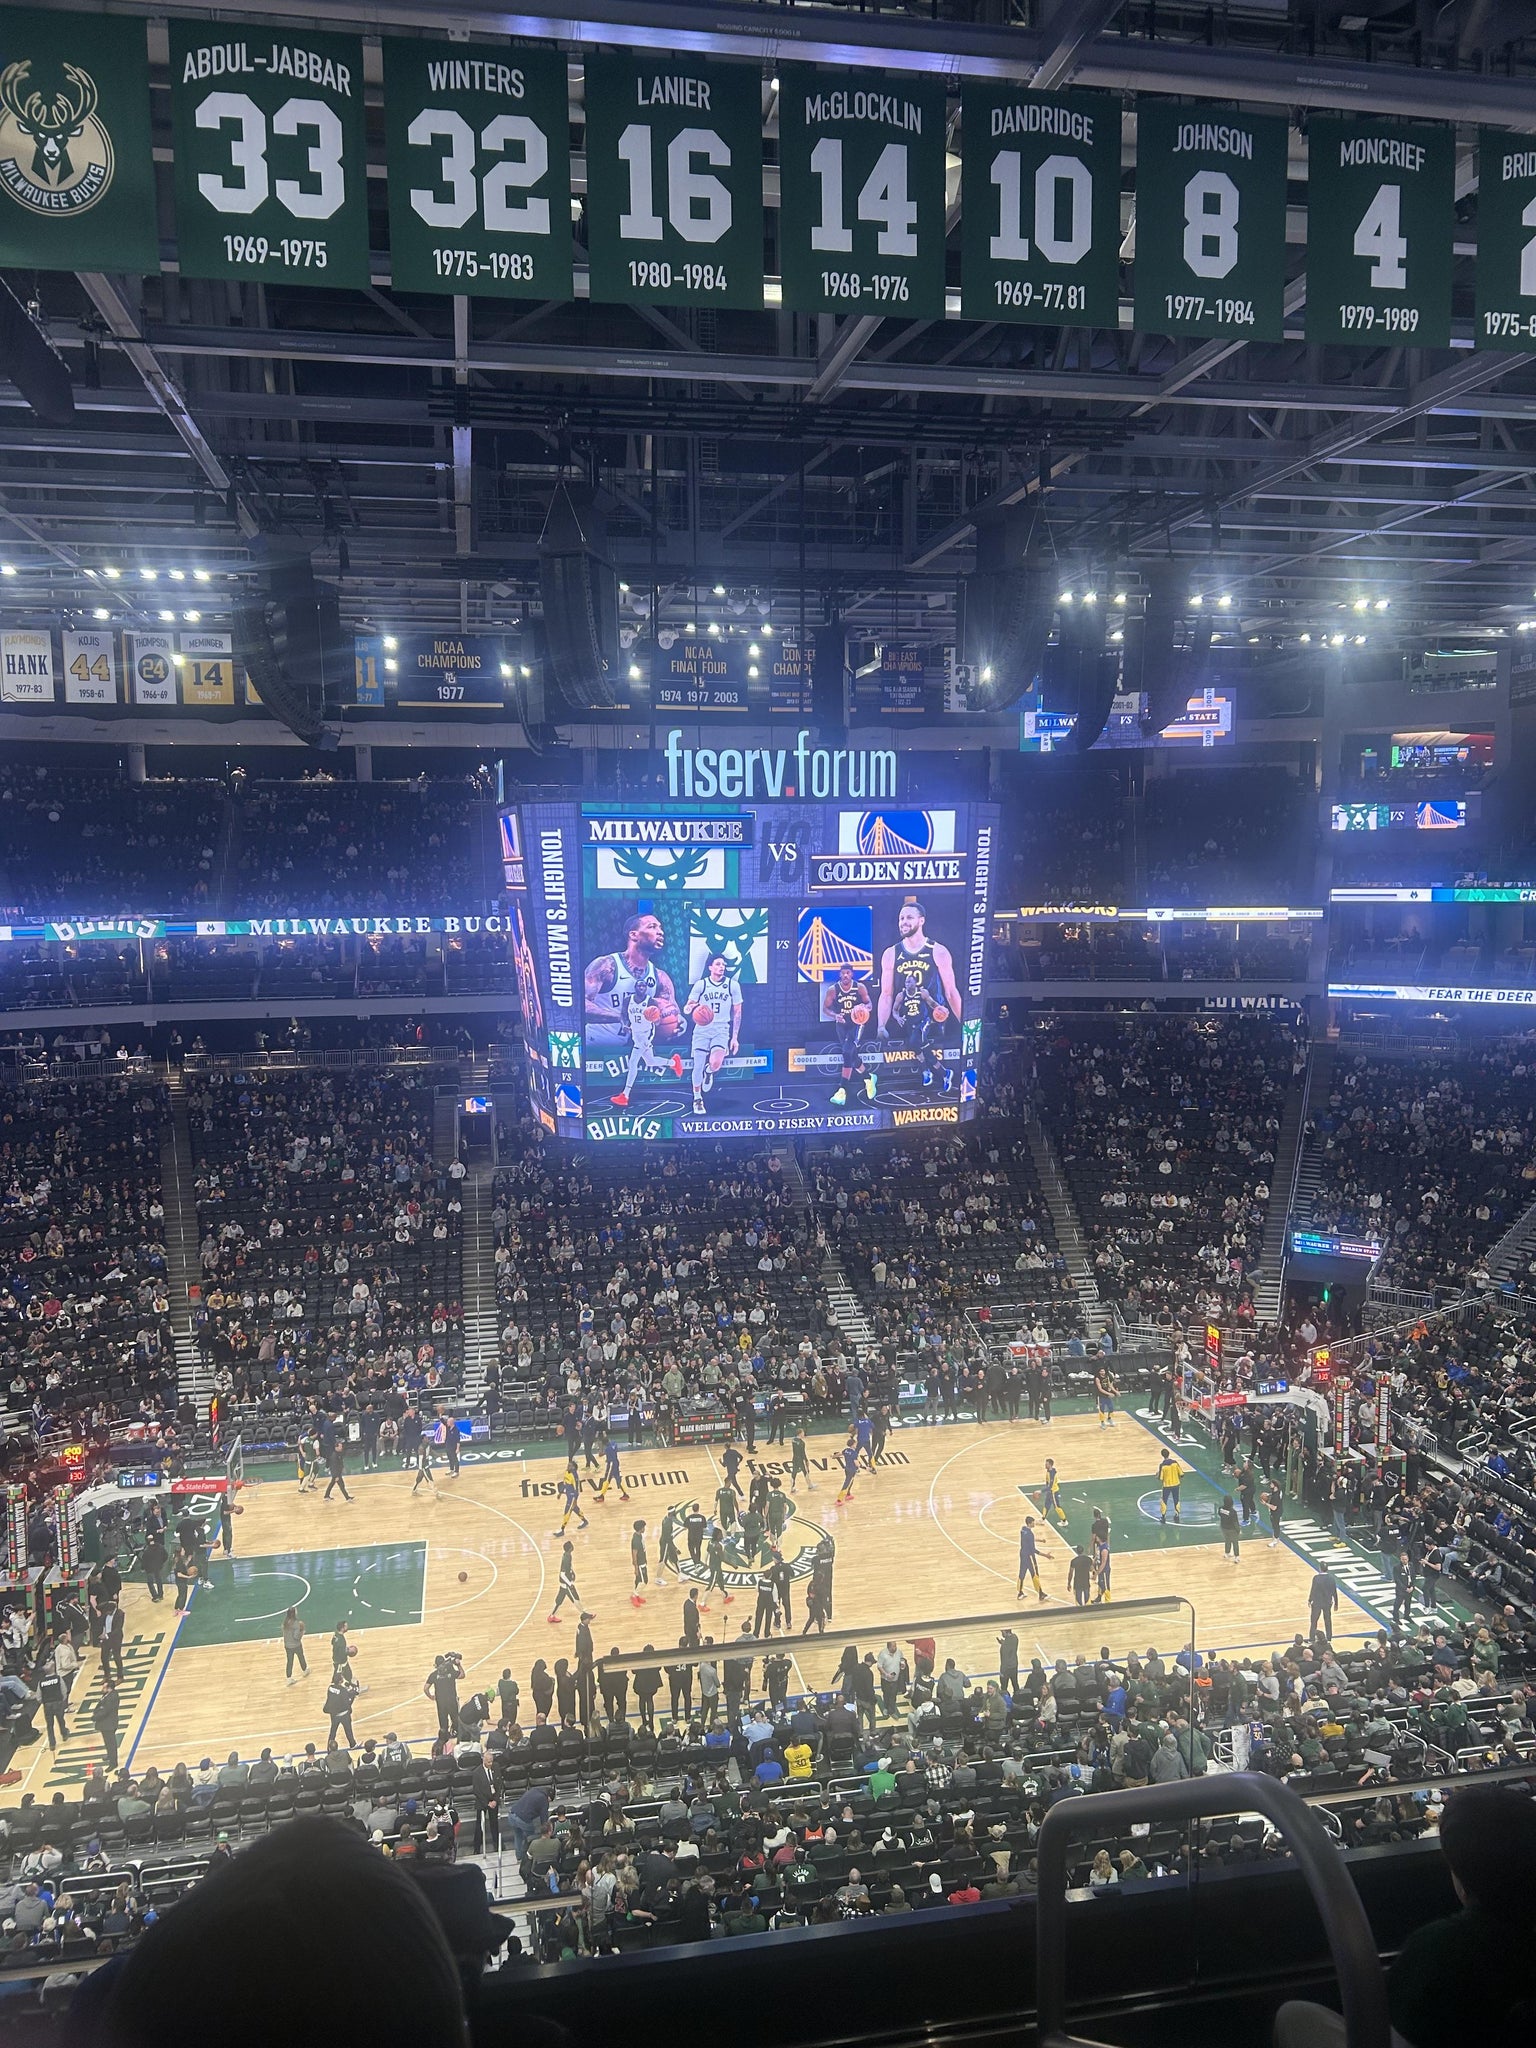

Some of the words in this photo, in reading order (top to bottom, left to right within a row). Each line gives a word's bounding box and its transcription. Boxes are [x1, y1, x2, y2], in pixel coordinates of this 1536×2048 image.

[182, 42, 351, 96] ABDUL-JABBAR
[428, 60, 525, 99] WINTERS
[636, 76, 711, 111] LANIER
[805, 91, 922, 134] McGLOCKLIN
[991, 105, 1094, 146] DANDRIDGE
[1172, 124, 1253, 160] JOHNSON
[195, 92, 345, 219] 33
[1339, 138, 1426, 172] MONCRIEF
[408, 108, 550, 234] 32
[0, 160, 69, 207] MILWAUKEE
[70, 165, 105, 204] BUCKS
[617, 123, 732, 243] 16
[810, 137, 917, 257] 14
[990, 150, 1093, 264] 10
[1183, 170, 1240, 280] 8
[1353, 184, 1407, 290] 4
[223, 234, 328, 268] 1969-1975
[432, 248, 534, 281] 1975-1983
[628, 260, 728, 292] 1980-1984
[821, 271, 910, 302] 1968-1976
[1165, 294, 1255, 326] 1977-1984
[1339, 305, 1419, 332] 1979-1989
[78, 636, 100, 647] KOJIS
[135, 638, 169, 649] THOMPSON
[188, 639, 224, 650] MEMINGER
[434, 641, 464, 653] NCAA
[418, 655, 481, 669] CHAMPIONS
[685, 646, 713, 659] NCAA
[901, 652, 917, 661] EAST
[6, 654, 49, 675] HANK
[70, 654, 111, 682] 44
[142, 659, 166, 679] 24
[192, 663, 223, 686] 14
[702, 661, 727, 674] FOUR
[15, 684, 43, 694] 1977-83
[79, 689, 105, 699] 1958-61
[142, 689, 168, 699] 1966-69
[437, 686, 464, 700] 1977
[660, 690, 682, 702] 1974
[687, 691, 709, 702] 1977
[714, 692, 738, 703] 2003
[1120, 715, 1133, 725] VS
[1189, 713, 1218, 721] STATE
[664, 730, 897, 798] fiserv.forum
[1390, 811, 1405, 821] VS
[589, 820, 743, 842] MILWAUKEE
[768, 842, 798, 862] VS
[817, 861, 900, 883] GOLDEN
[903, 859, 960, 881] STATE
[249, 916, 432, 936] MILWAUKEE
[776, 940, 790, 950] VS
[546, 924, 573, 1007] MATCHUP
[968, 917, 985, 996] MATCHUP
[897, 961, 930, 974] GOLDEN
[703, 991, 730, 1002] BUCKS
[843, 1000, 852, 1009] 10
[1428, 989, 1463, 1001] FEAR
[1467, 989, 1493, 1001] THE
[1496, 990, 1533, 1002] DEER
[909, 1004, 918, 1012] 23
[562, 1073, 572, 1082] VS
[587, 1117, 661, 1140] BUCKS
[681, 1120, 752, 1133] WELCOME
[755, 1120, 774, 1132] TO
[778, 1117, 824, 1130] FISERV
[827, 1114, 875, 1127] FORUM
[893, 1107, 959, 1127] WARRIORS
[679, 1425, 695, 1433] BLACK
[695, 1423, 714, 1432] HISTORY
[66, 1456, 79, 1464] 24
[41, 1677, 58, 1688] PHOTO
[794, 1758, 807, 1768] 30
